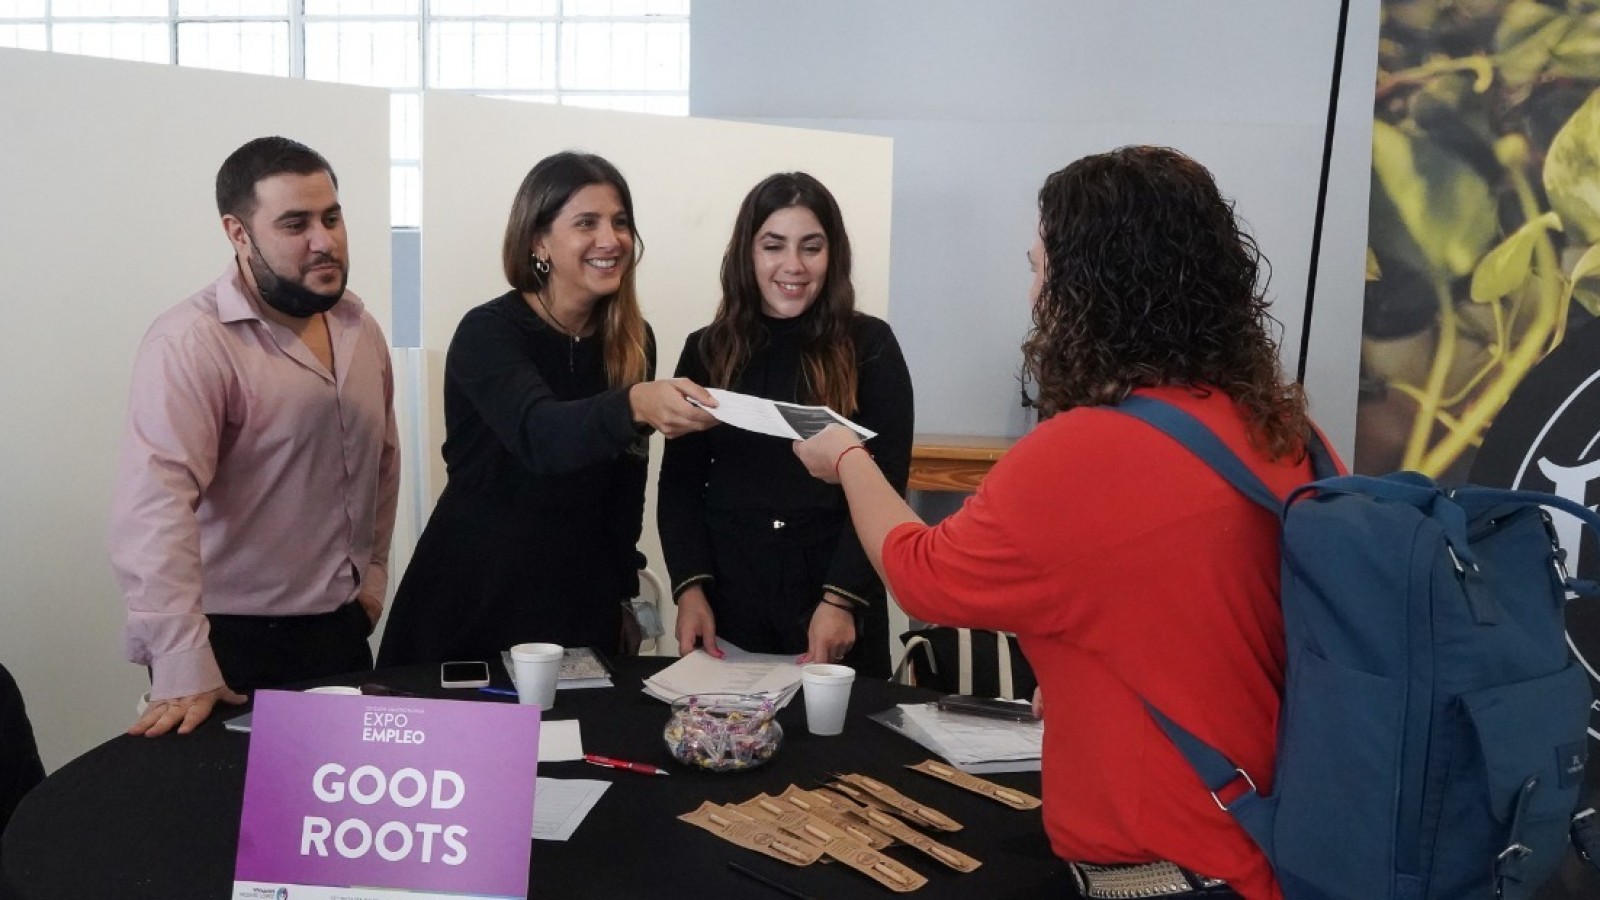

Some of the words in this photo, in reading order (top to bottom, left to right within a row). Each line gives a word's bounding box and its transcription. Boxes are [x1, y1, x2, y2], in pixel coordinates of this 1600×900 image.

[364, 712, 408, 728] EXPO
[363, 728, 425, 745] EMPLEO
[313, 763, 466, 809] GOOD
[300, 816, 469, 866] ROOTS
